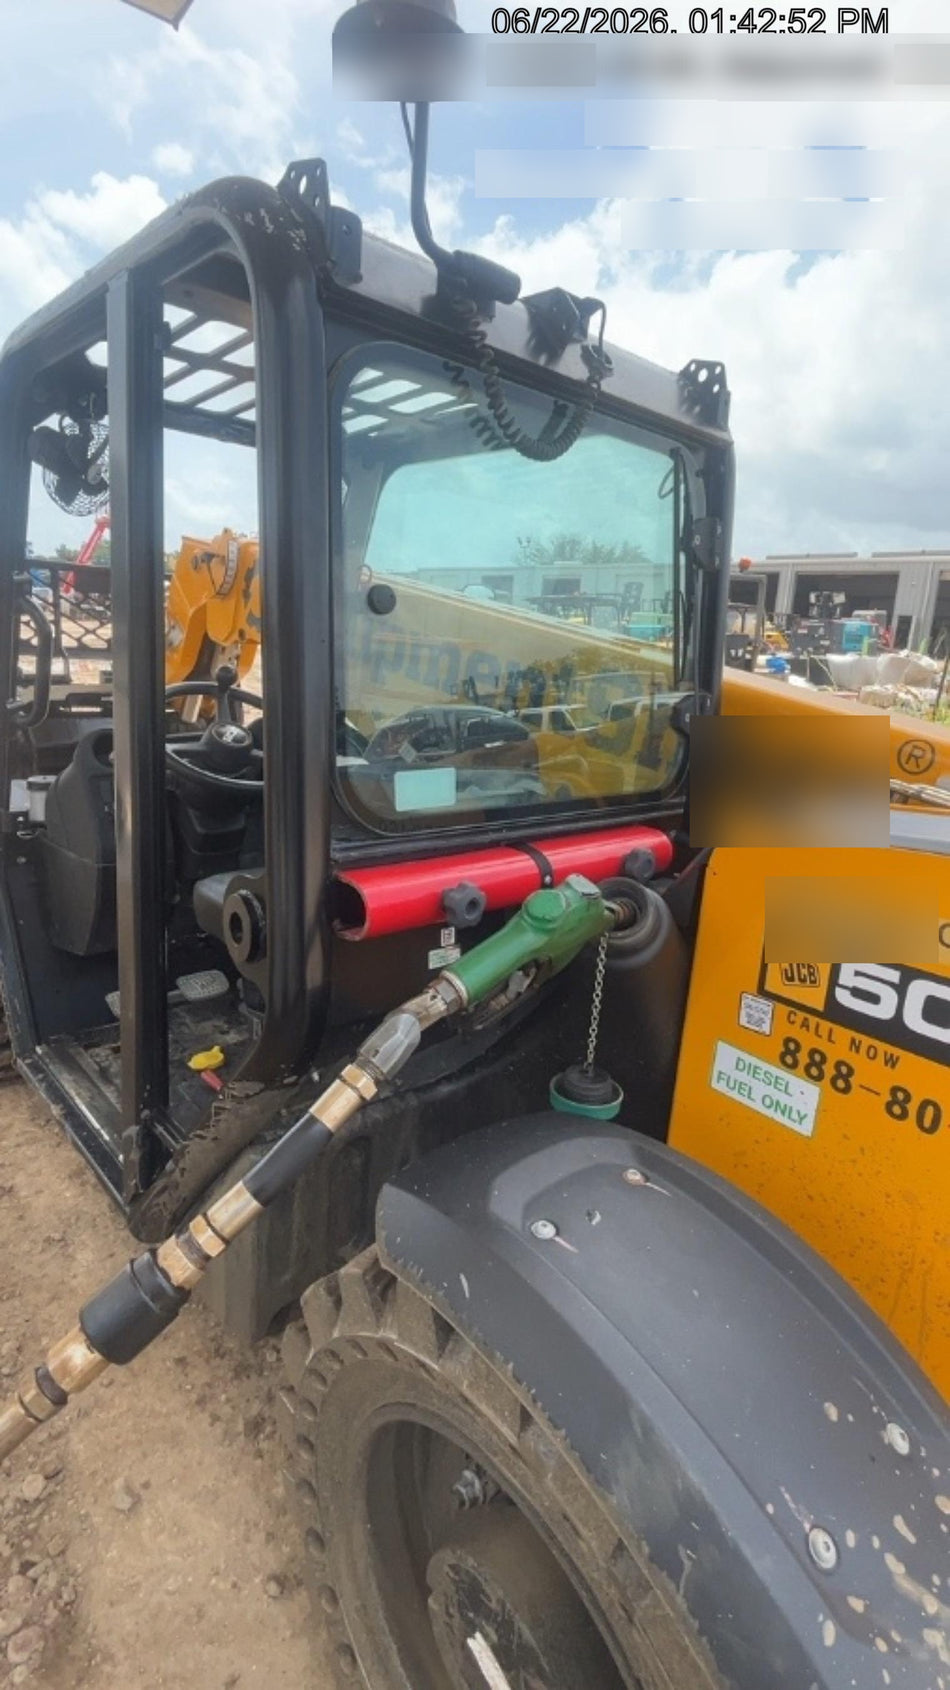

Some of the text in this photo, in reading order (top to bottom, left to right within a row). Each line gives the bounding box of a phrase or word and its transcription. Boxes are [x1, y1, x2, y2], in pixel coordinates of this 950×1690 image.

[784, 962, 817, 984] JCB
[787, 1010, 836, 1045] CALL
[848, 1037, 900, 1070] NOW
[716, 1070, 808, 1126] FUEL ONLY
[735, 1056, 793, 1098] DIESEL
